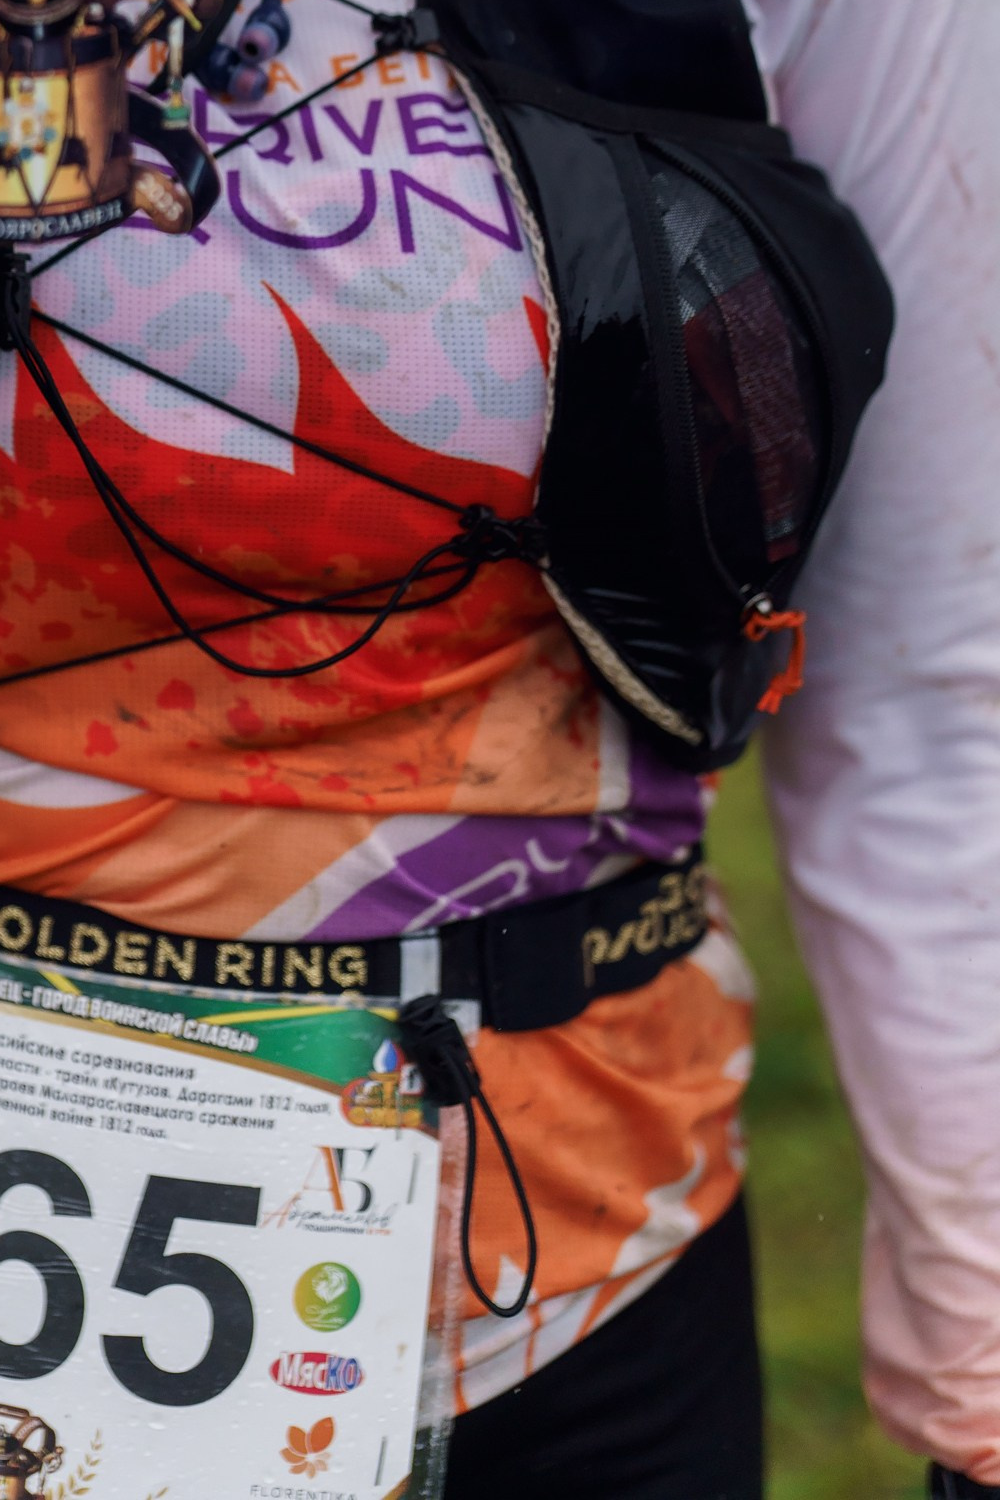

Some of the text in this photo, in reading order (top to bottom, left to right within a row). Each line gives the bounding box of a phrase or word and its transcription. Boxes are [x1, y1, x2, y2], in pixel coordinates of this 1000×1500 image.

[150, 85, 496, 166] RIVE
[215, 941, 369, 988] RING
[32, 986, 88, 1018] ГОРОД
[89, 996, 183, 1037] ВОИНСКОЙ
[71, 1046, 195, 1080] соревнования
[259, 1094, 292, 1112] 1812
[99, 1114, 132, 1134] 1812
